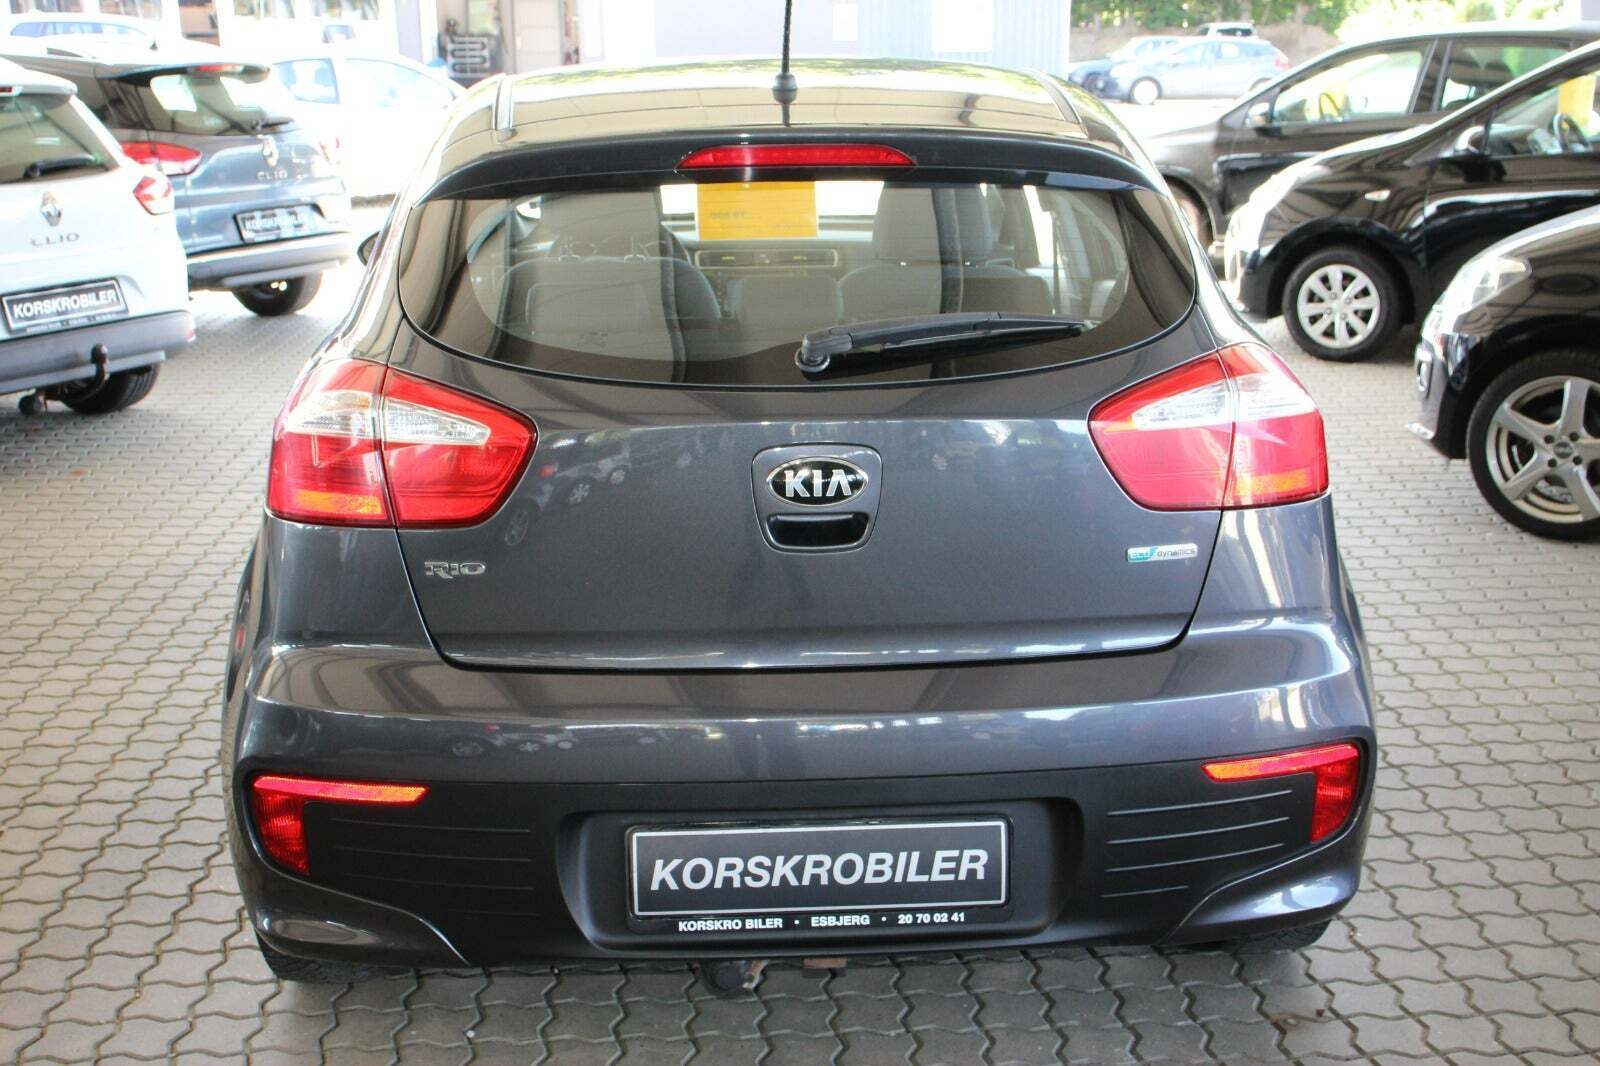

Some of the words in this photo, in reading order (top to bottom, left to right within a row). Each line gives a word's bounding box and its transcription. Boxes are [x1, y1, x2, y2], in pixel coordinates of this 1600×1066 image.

[30, 232, 80, 246] CLIO
[12, 289, 117, 319] KORSKROBILER
[784, 469, 852, 498] KIA
[424, 561, 487, 579] RIO
[650, 848, 990, 892] KORSKROBILER
[678, 919, 743, 933] KORSKRO
[745, 917, 783, 930] BILER
[810, 914, 871, 928] ESBJERG
[897, 913, 914, 925] 20
[914, 913, 931, 924] 70
[932, 912, 949, 924] 02
[949, 911, 966, 923] 41
